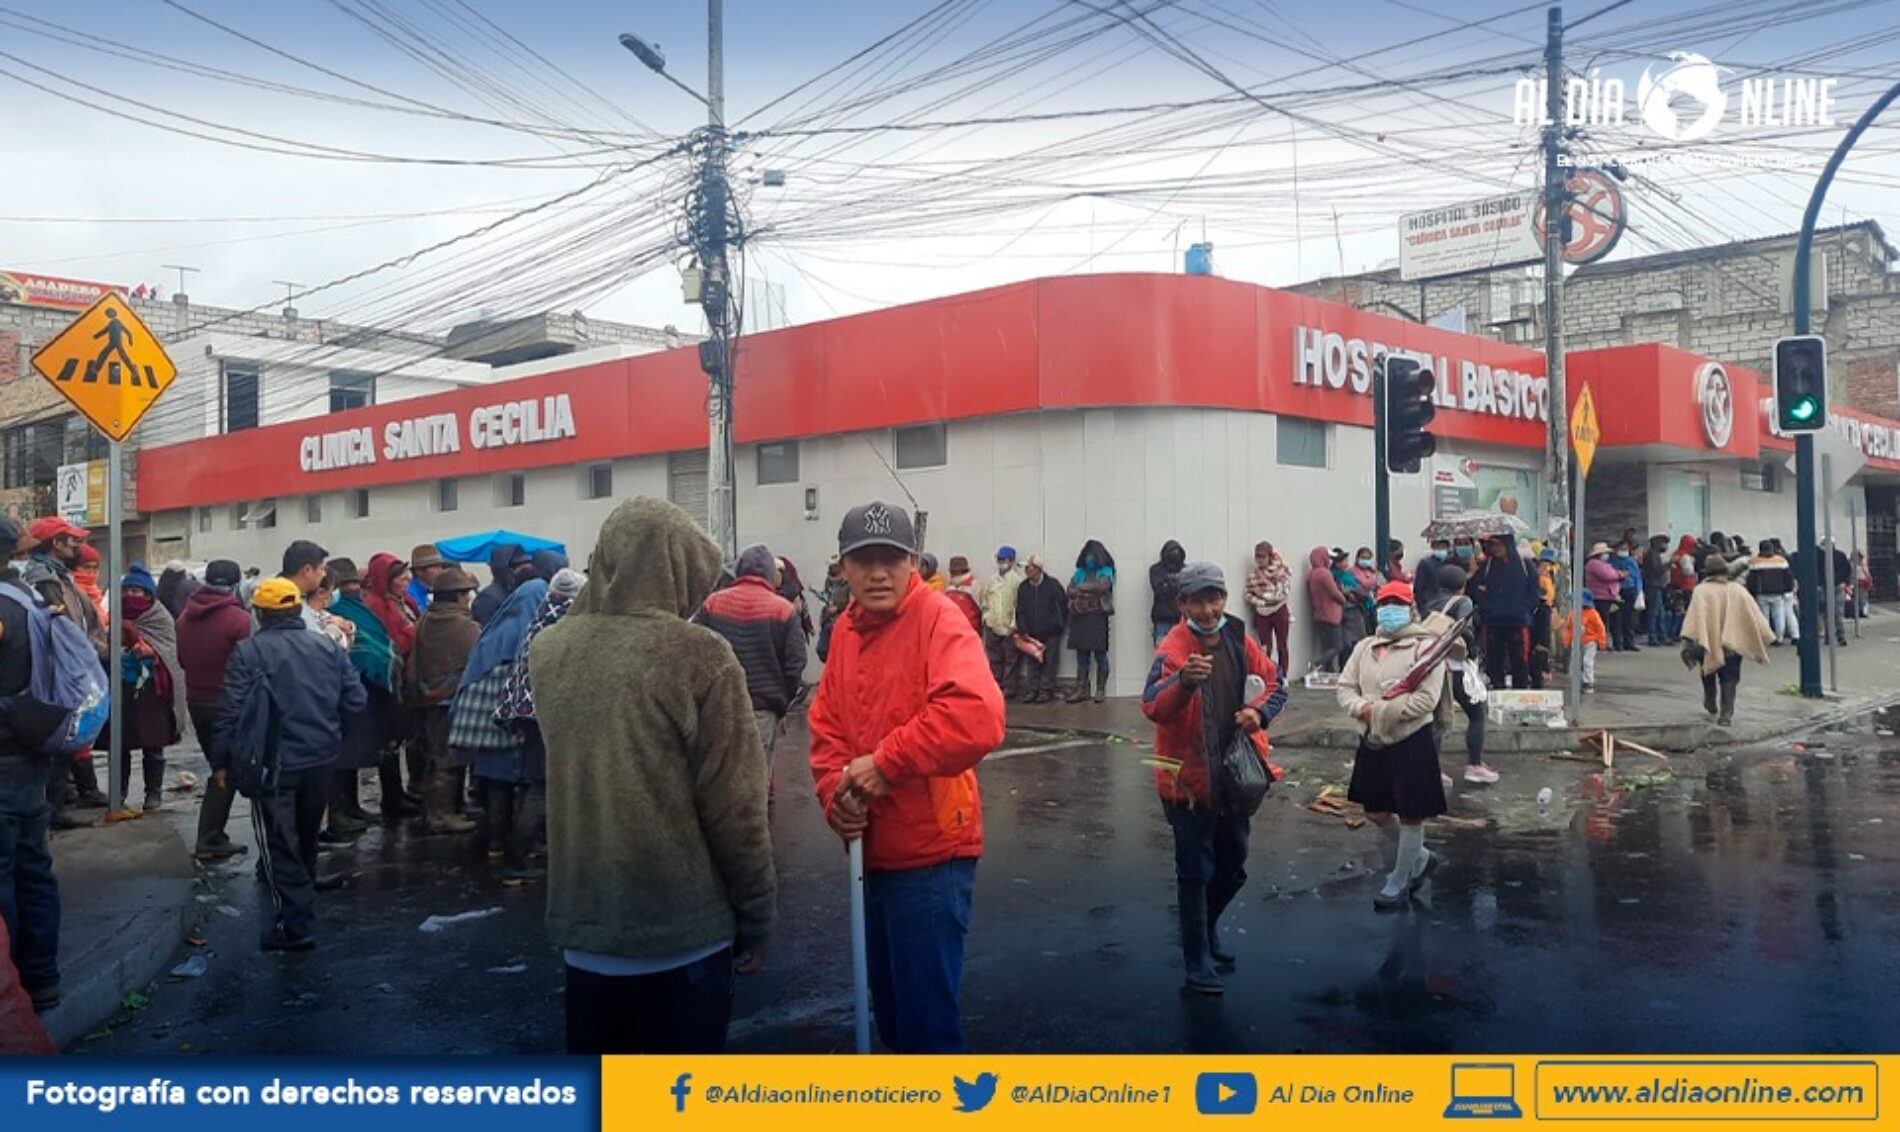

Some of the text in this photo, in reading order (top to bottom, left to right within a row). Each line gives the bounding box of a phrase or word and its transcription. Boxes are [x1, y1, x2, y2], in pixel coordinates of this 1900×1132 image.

[1294, 326, 1456, 407] HOSAL
[300, 393, 576, 472] CLINICA SANTA CECILIA
